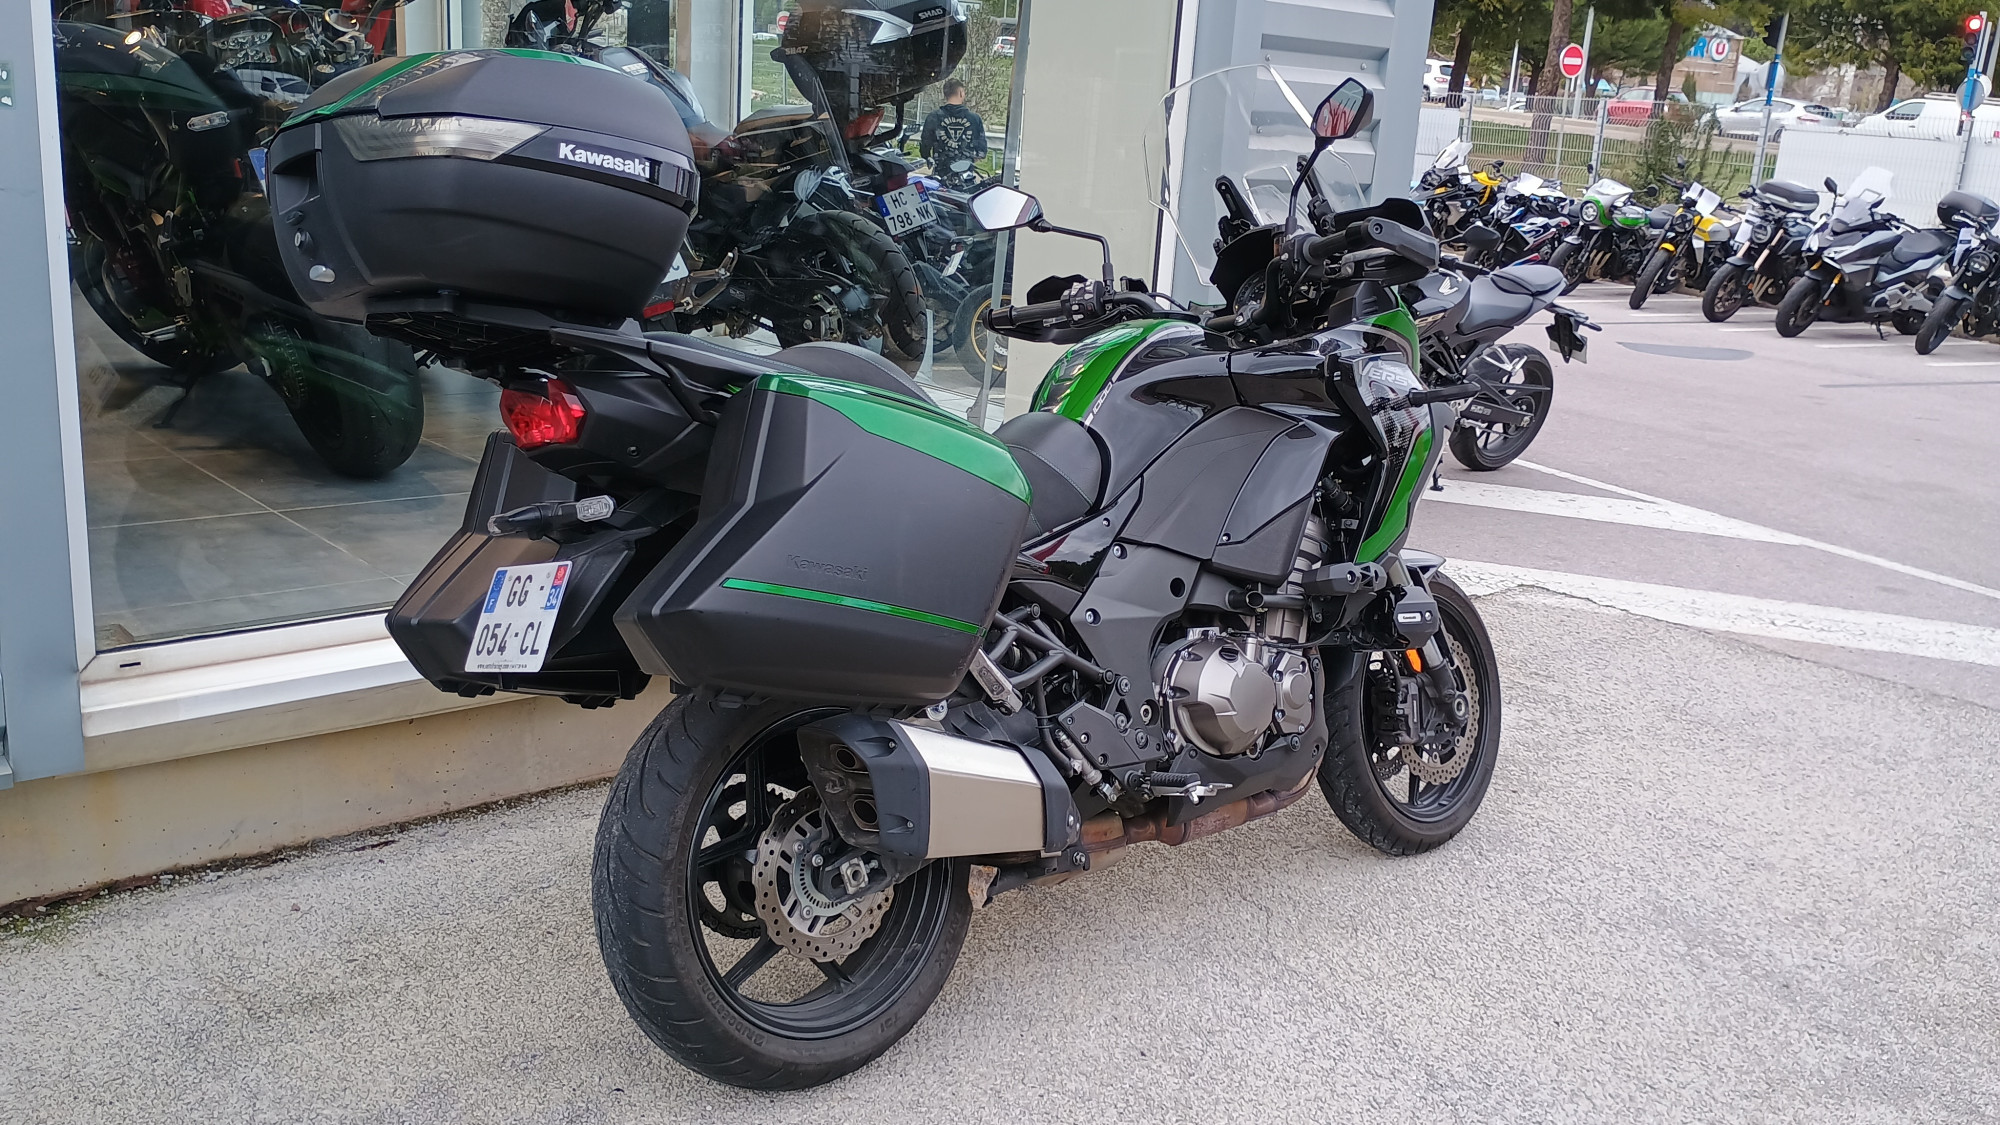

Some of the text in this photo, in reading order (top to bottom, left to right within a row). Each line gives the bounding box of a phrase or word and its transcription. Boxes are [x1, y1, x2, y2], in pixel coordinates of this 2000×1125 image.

[918, 8, 943, 20] SHAD
[1686, 36, 1726, 58] R U
[940, 116, 971, 128] TRIUMPH
[559, 142, 650, 179] Kawasaki
[890, 191, 908, 210] HC
[889, 205, 934, 232] 798-NK
[1092, 381, 1113, 415] 1000
[786, 554, 869, 582] Kawasaki
[488, 598, 496, 610] F
[506, 574, 534, 608] GG
[546, 588, 560, 607] 34
[475, 620, 542, 657] 054-CL
[696, 976, 766, 1048] BRIDGESTONE
